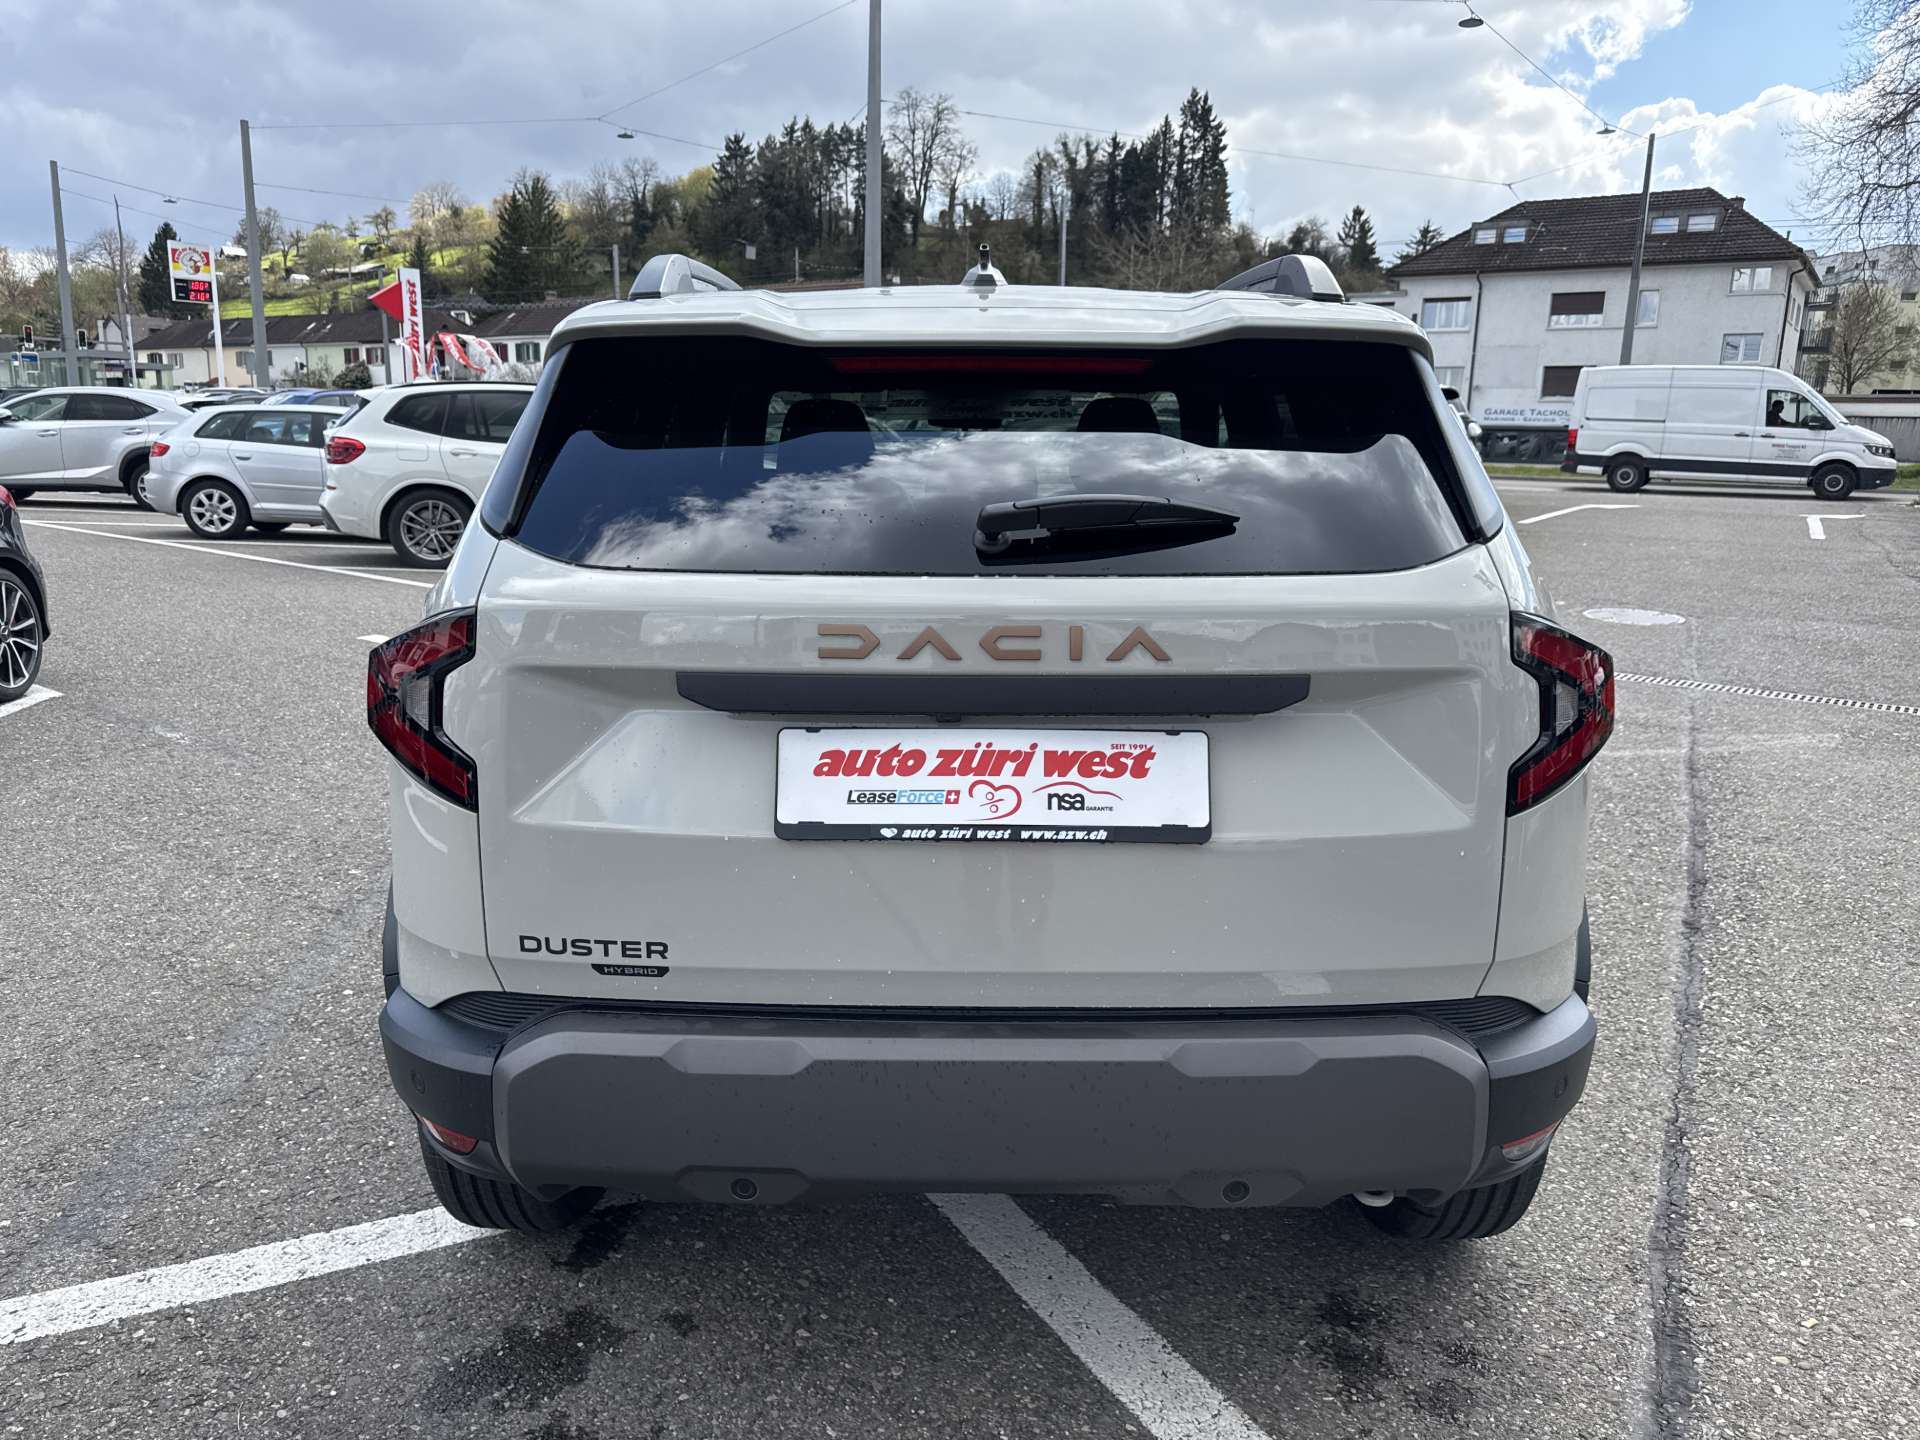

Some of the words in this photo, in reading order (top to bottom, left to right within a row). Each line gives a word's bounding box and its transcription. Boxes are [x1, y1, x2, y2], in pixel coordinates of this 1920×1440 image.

[407, 279, 418, 318] west
[1484, 407, 1526, 416] GARAGE
[818, 624, 1171, 661] DACIA
[1129, 743, 1148, 751] 1991
[813, 742, 927, 777] auto
[927, 742, 1039, 777] züri
[1043, 745, 1156, 779] west
[1047, 792, 1085, 811] nsa
[901, 828, 937, 839] auto
[939, 827, 972, 839] züri
[976, 829, 1011, 839] west
[1020, 829, 1108, 841] www.azw.ch
[519, 935, 669, 960] DUSTER
[604, 966, 658, 975] HYBRID
